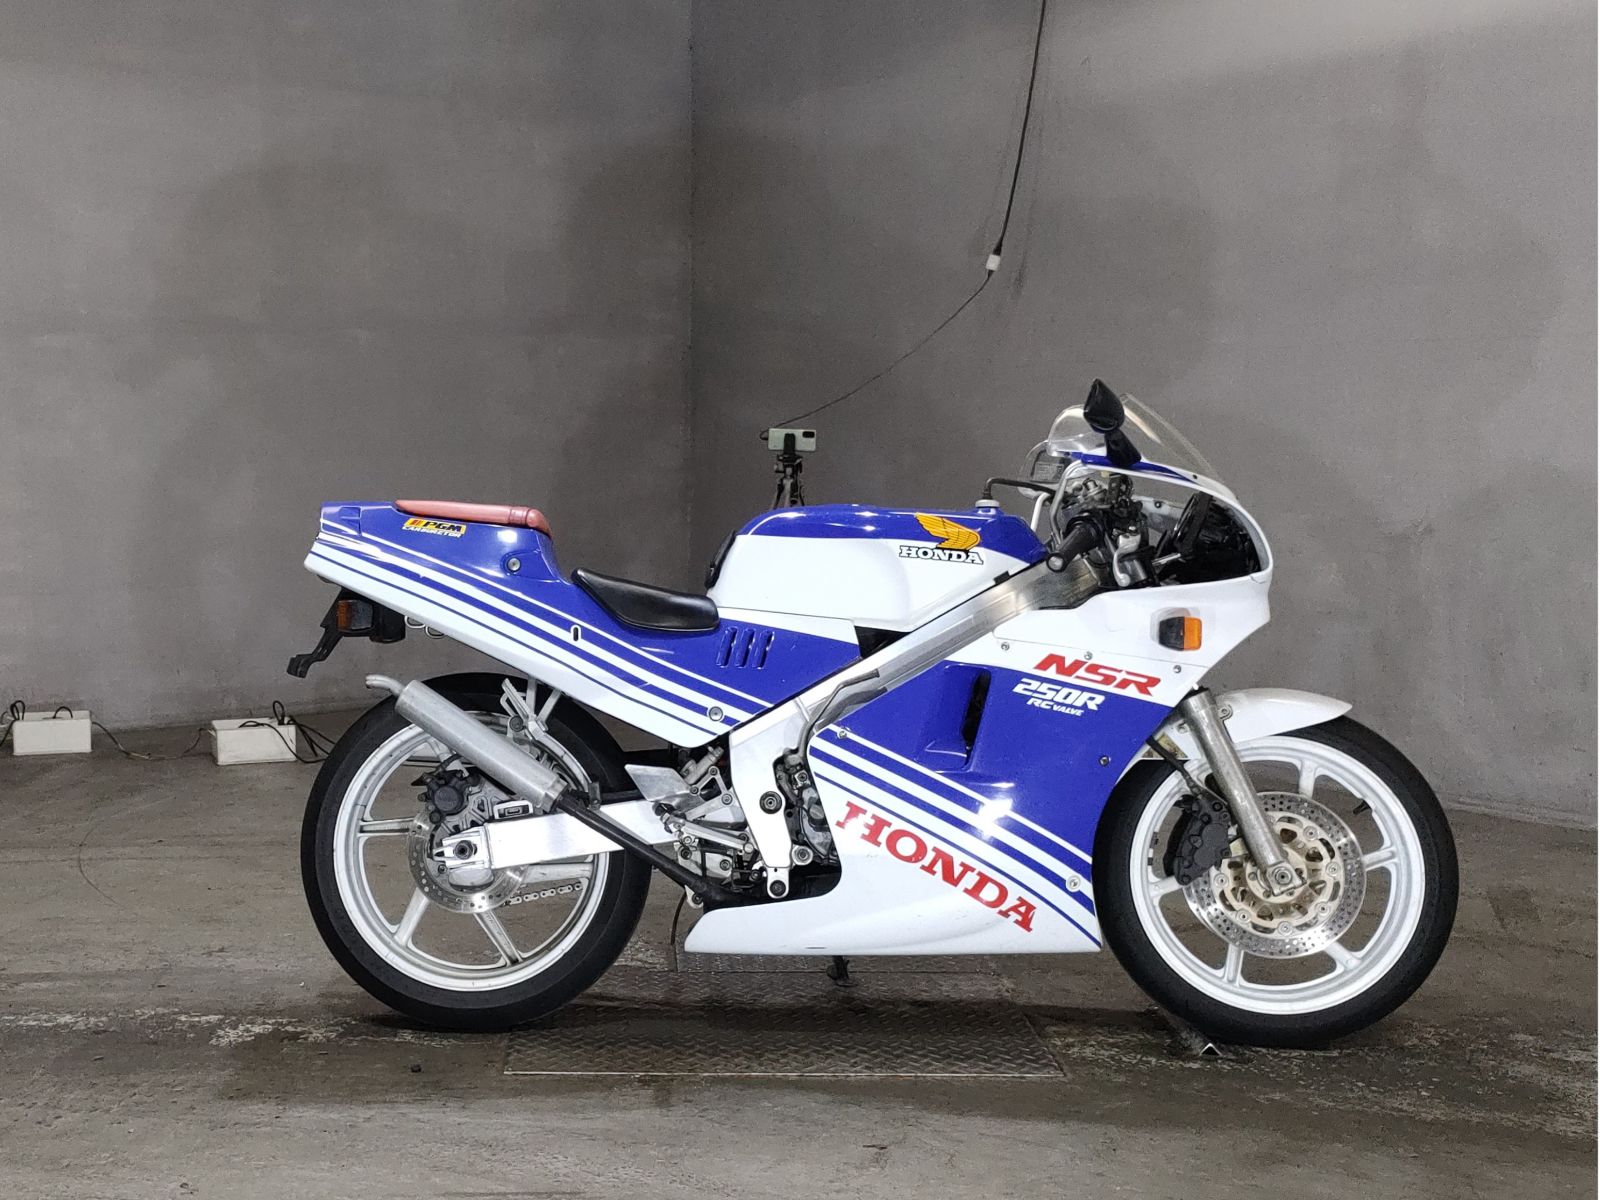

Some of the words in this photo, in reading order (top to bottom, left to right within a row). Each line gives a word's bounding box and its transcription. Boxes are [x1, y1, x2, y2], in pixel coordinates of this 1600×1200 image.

[423, 521, 463, 532] PGM
[899, 545, 984, 565] HONDA
[1033, 653, 1161, 697] NSR
[1012, 677, 1106, 711] 250R
[835, 801, 1037, 933] HONDA
